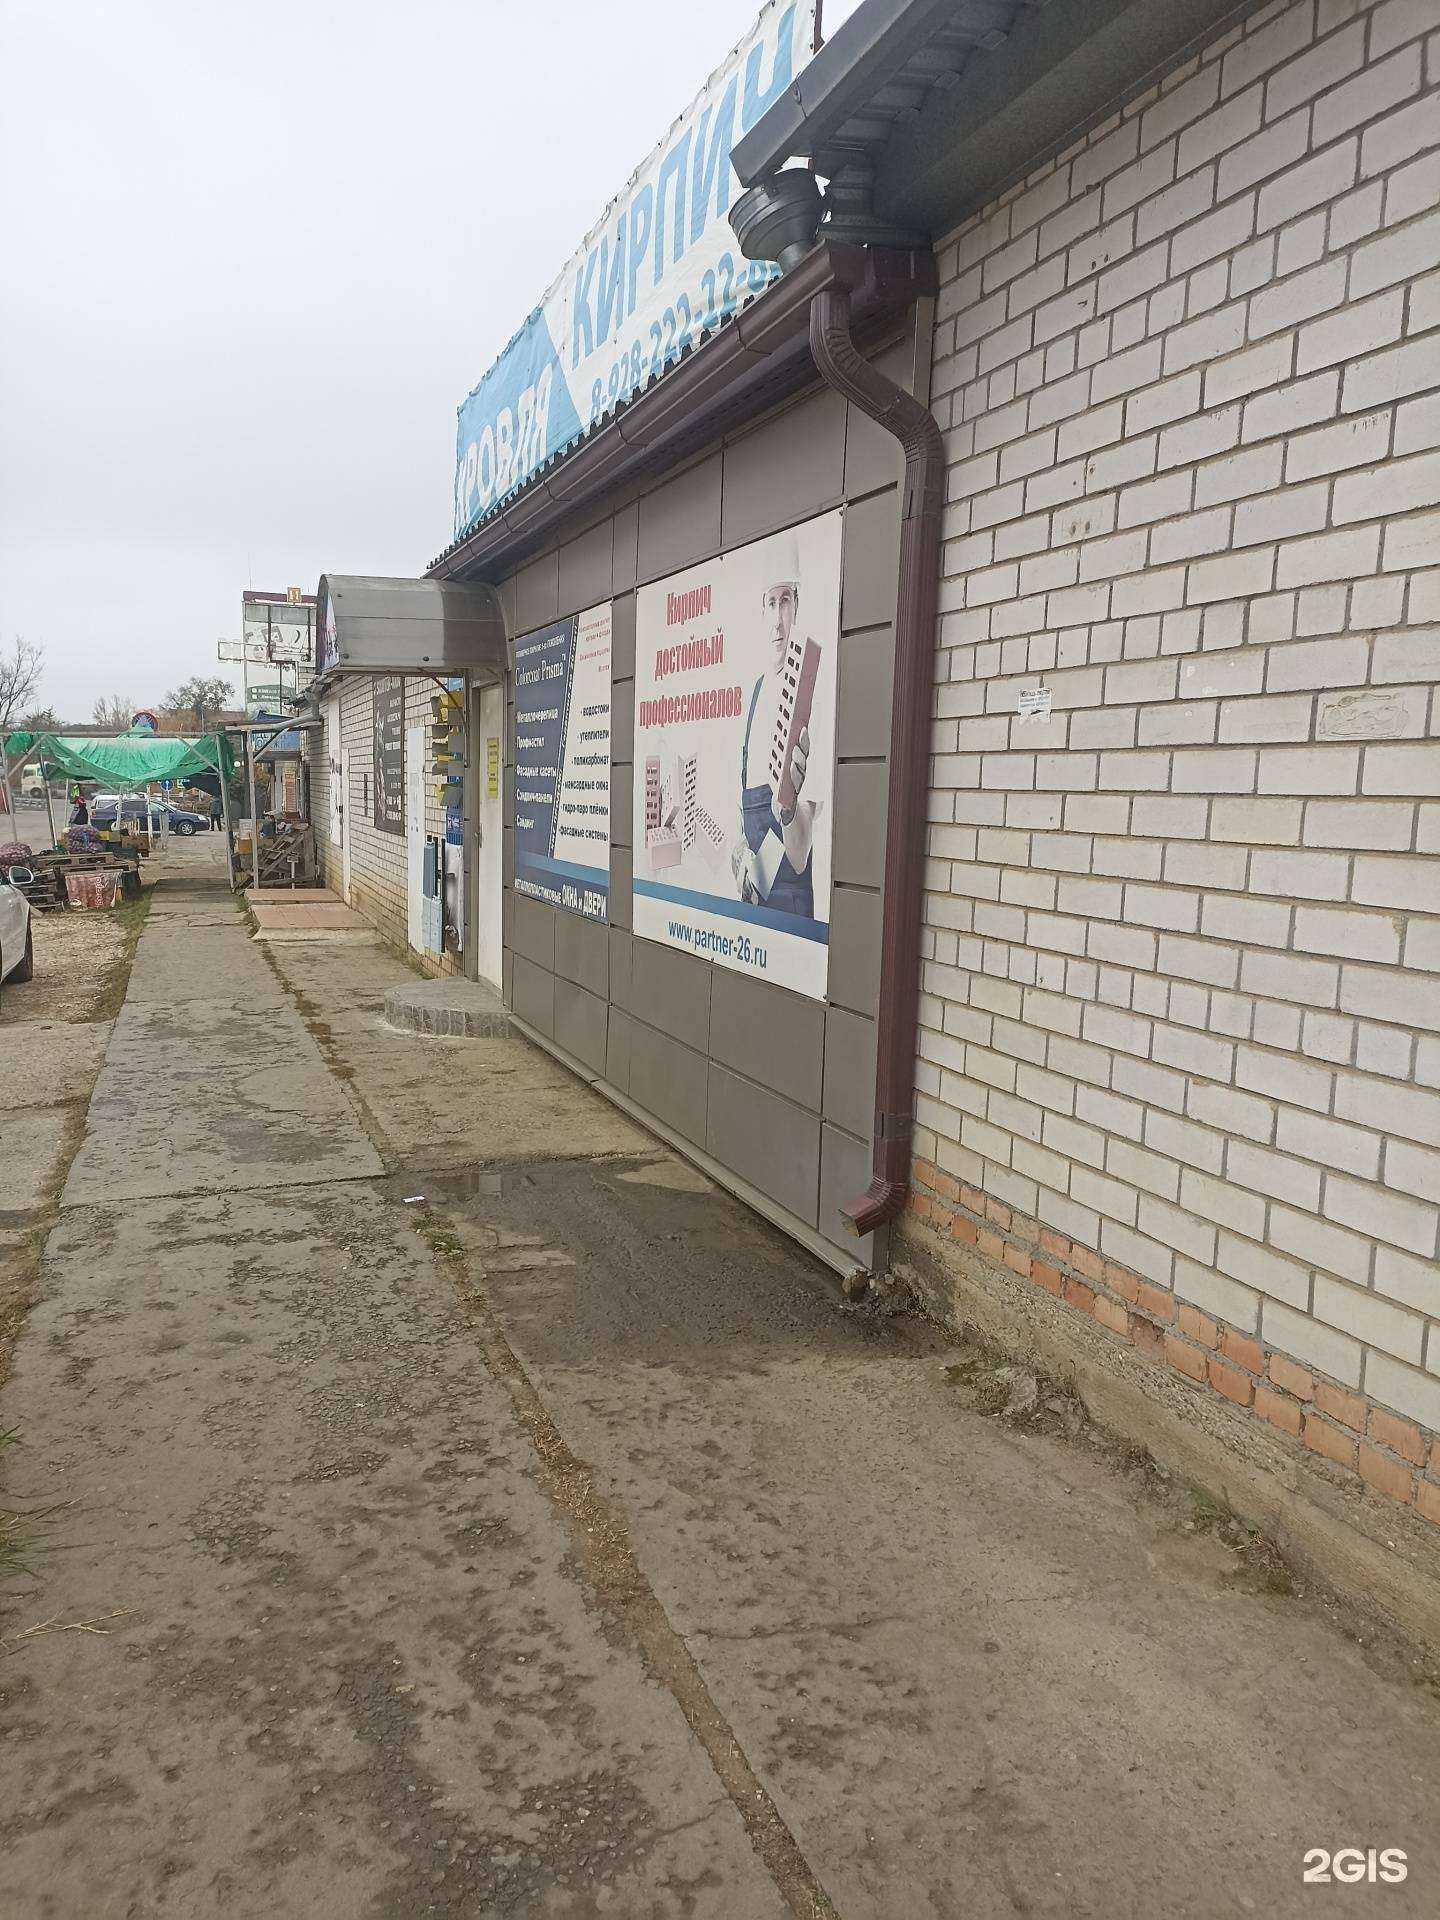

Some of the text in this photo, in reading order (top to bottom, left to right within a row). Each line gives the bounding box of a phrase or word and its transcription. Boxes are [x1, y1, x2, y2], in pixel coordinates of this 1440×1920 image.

[667, 585, 711, 625] Кирпич
[655, 627, 724, 681] достойный
[582, 704, 610, 717] водостоки
[639, 686, 742, 729] профессионалов
[579, 730, 610, 743] утеплители
[562, 884, 578, 909] ОКНА
[583, 890, 607, 918] ДВЕРИ
[668, 921, 767, 968] www.partner-26.ru
